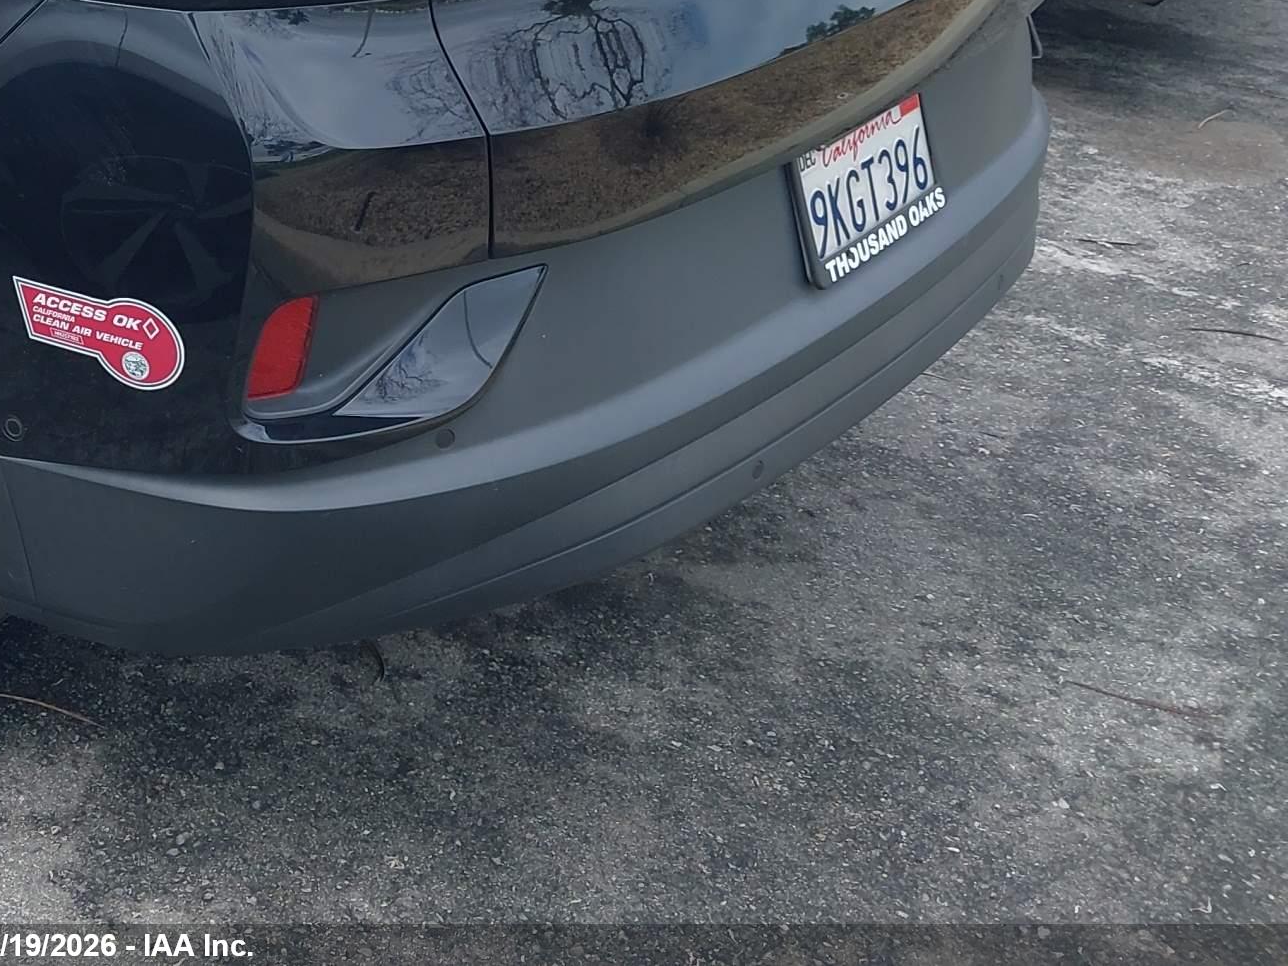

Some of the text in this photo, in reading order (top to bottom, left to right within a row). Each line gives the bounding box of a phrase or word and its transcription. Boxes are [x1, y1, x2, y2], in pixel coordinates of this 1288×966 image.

[817, 110, 903, 168] California
[809, 125, 929, 260] 9KGT396
[824, 215, 908, 283] THOUSAND
[32, 292, 143, 332] ACCESS OK
[32, 306, 76, 323] CALIFORNIA
[32, 313, 70, 331] CLEAN
[72, 324, 92, 337] AIR
[95, 330, 144, 351] VEHICLE
